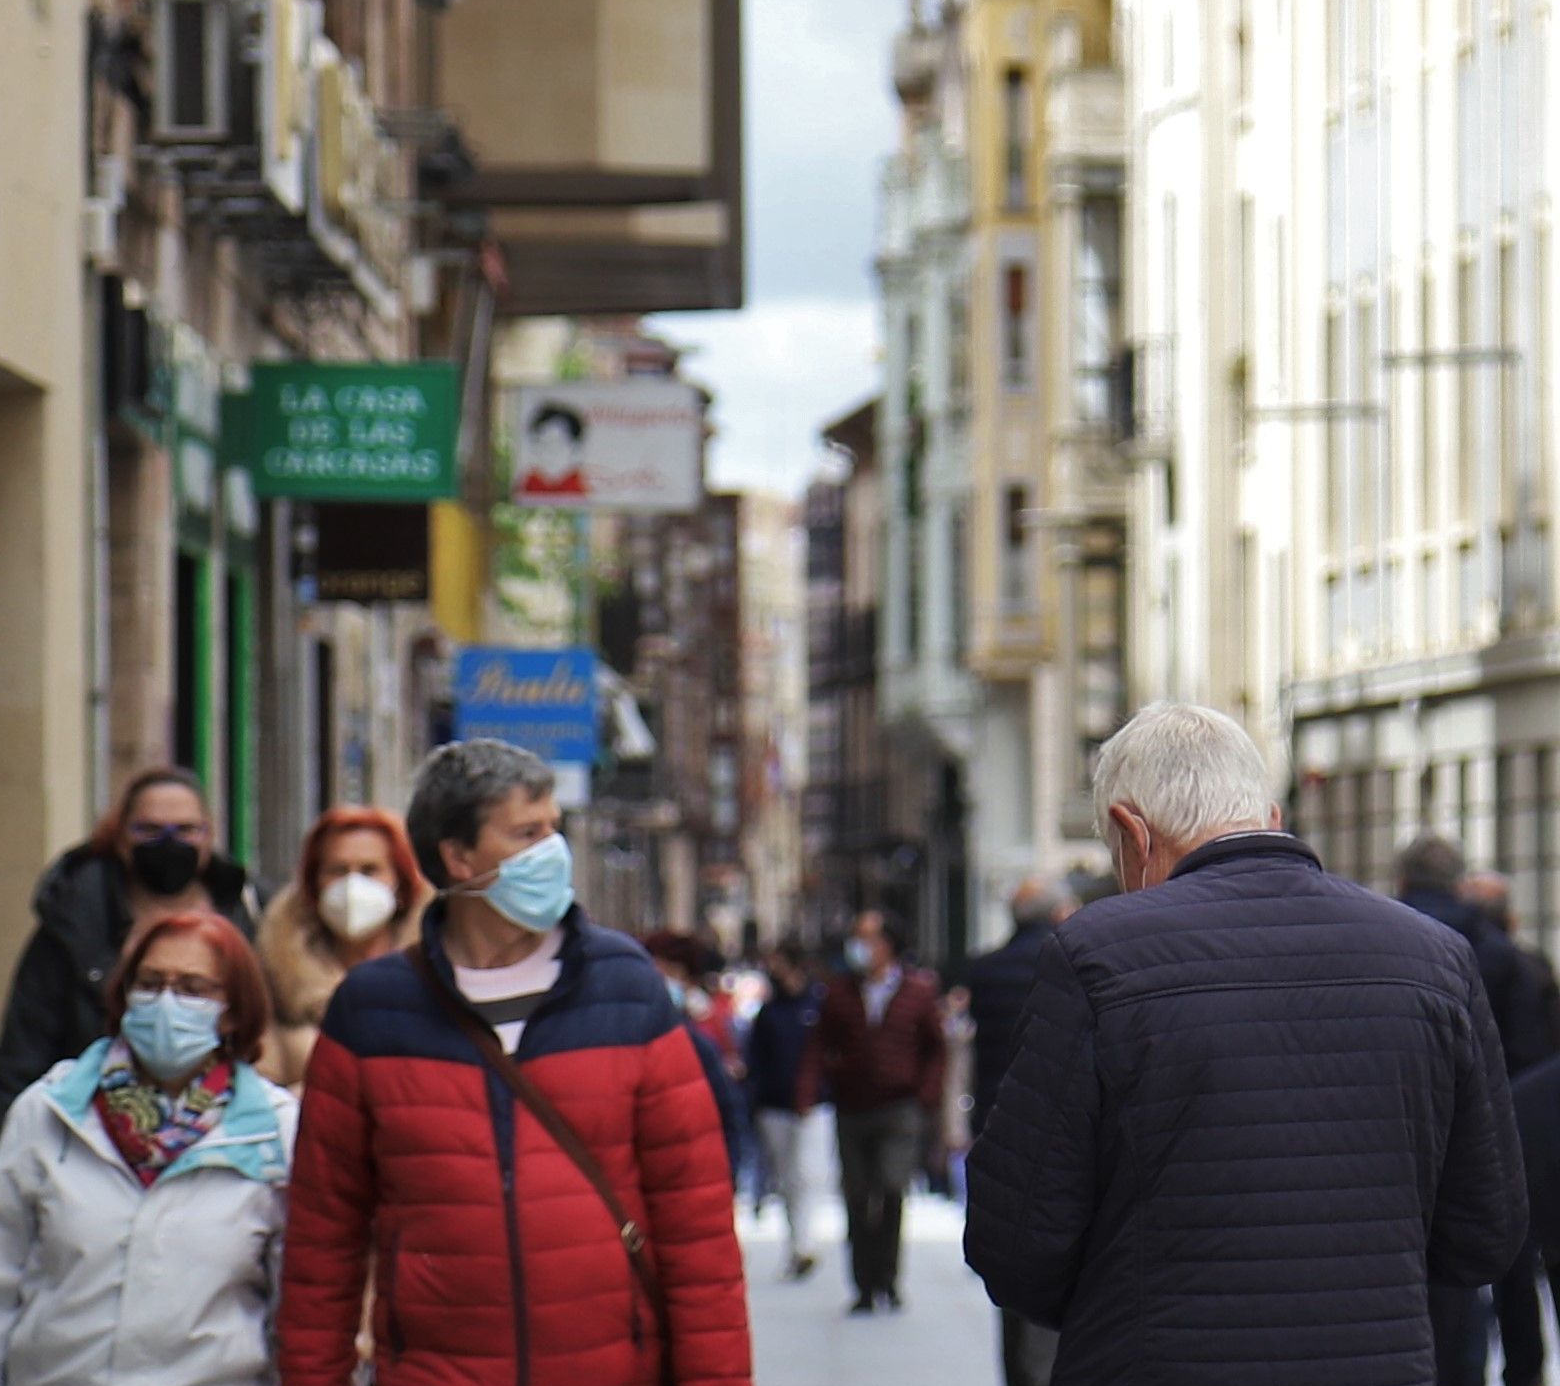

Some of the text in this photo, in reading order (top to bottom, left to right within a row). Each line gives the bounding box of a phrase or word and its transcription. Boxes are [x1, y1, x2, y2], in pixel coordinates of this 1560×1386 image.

[281, 385, 427, 416] LA CASA
[348, 418, 417, 447] LAS
[263, 448, 440, 480] CARCASAS
